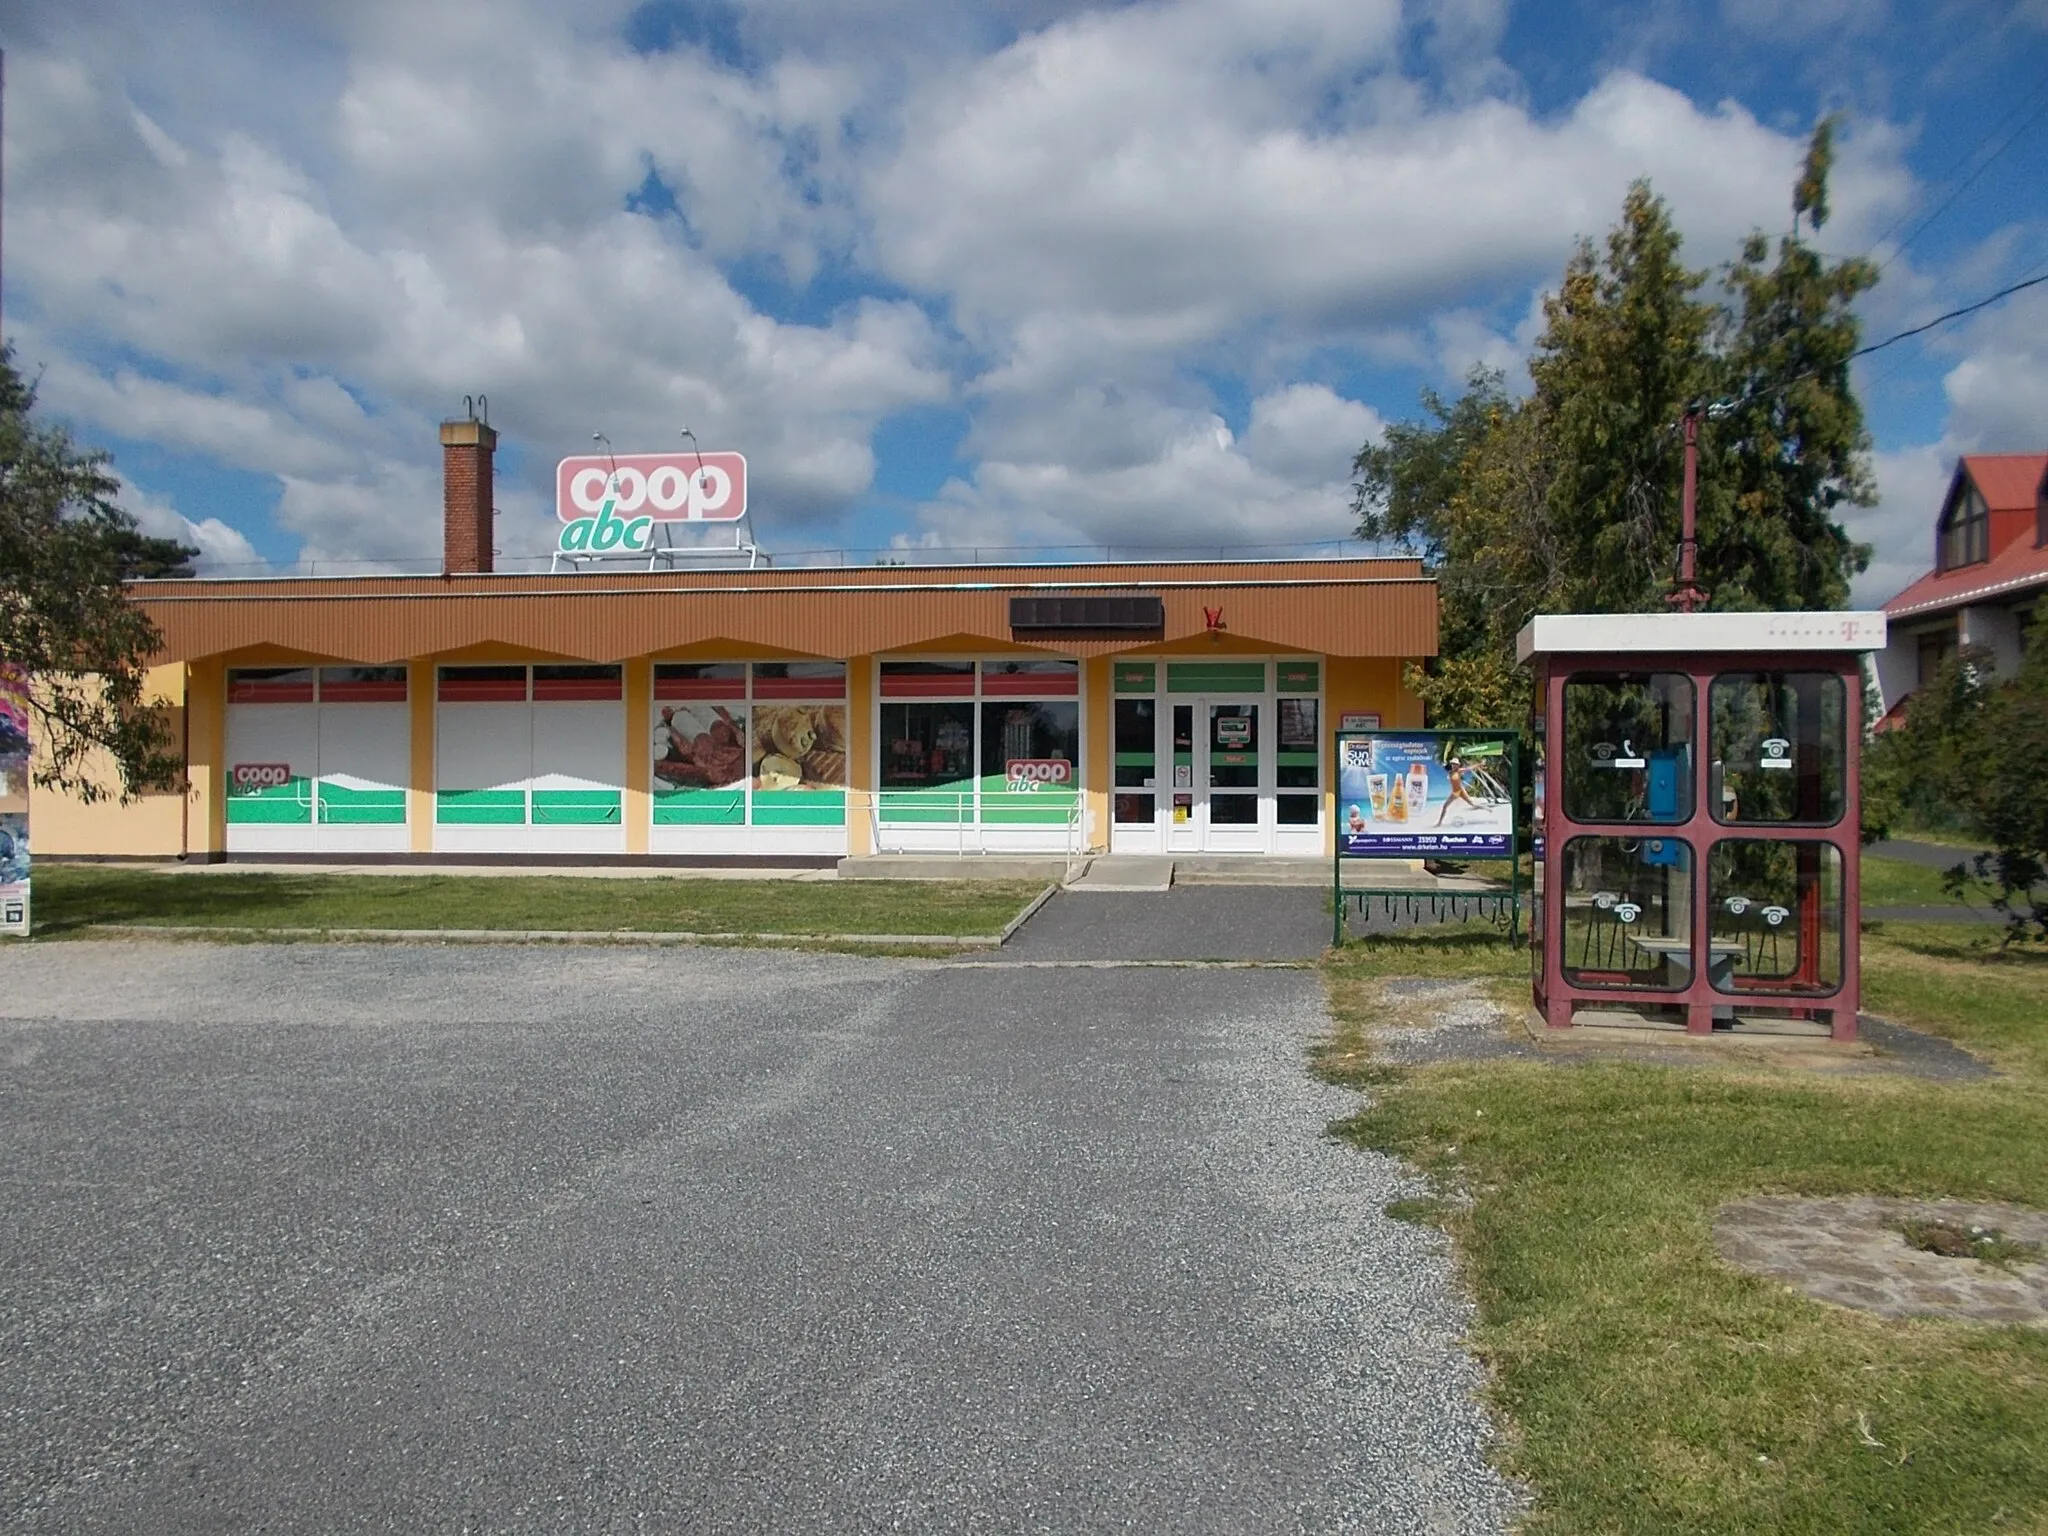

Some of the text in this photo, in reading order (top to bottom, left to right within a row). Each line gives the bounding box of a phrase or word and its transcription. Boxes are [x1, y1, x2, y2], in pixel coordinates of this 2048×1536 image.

[570, 465, 732, 520] coop
[560, 500, 651, 551] abc
[1841, 621, 1859, 642] T
[237, 767, 286, 785] coop
[1008, 775, 1038, 791] abc
[1011, 763, 1066, 783] coop
[236, 779, 261, 795] abc
